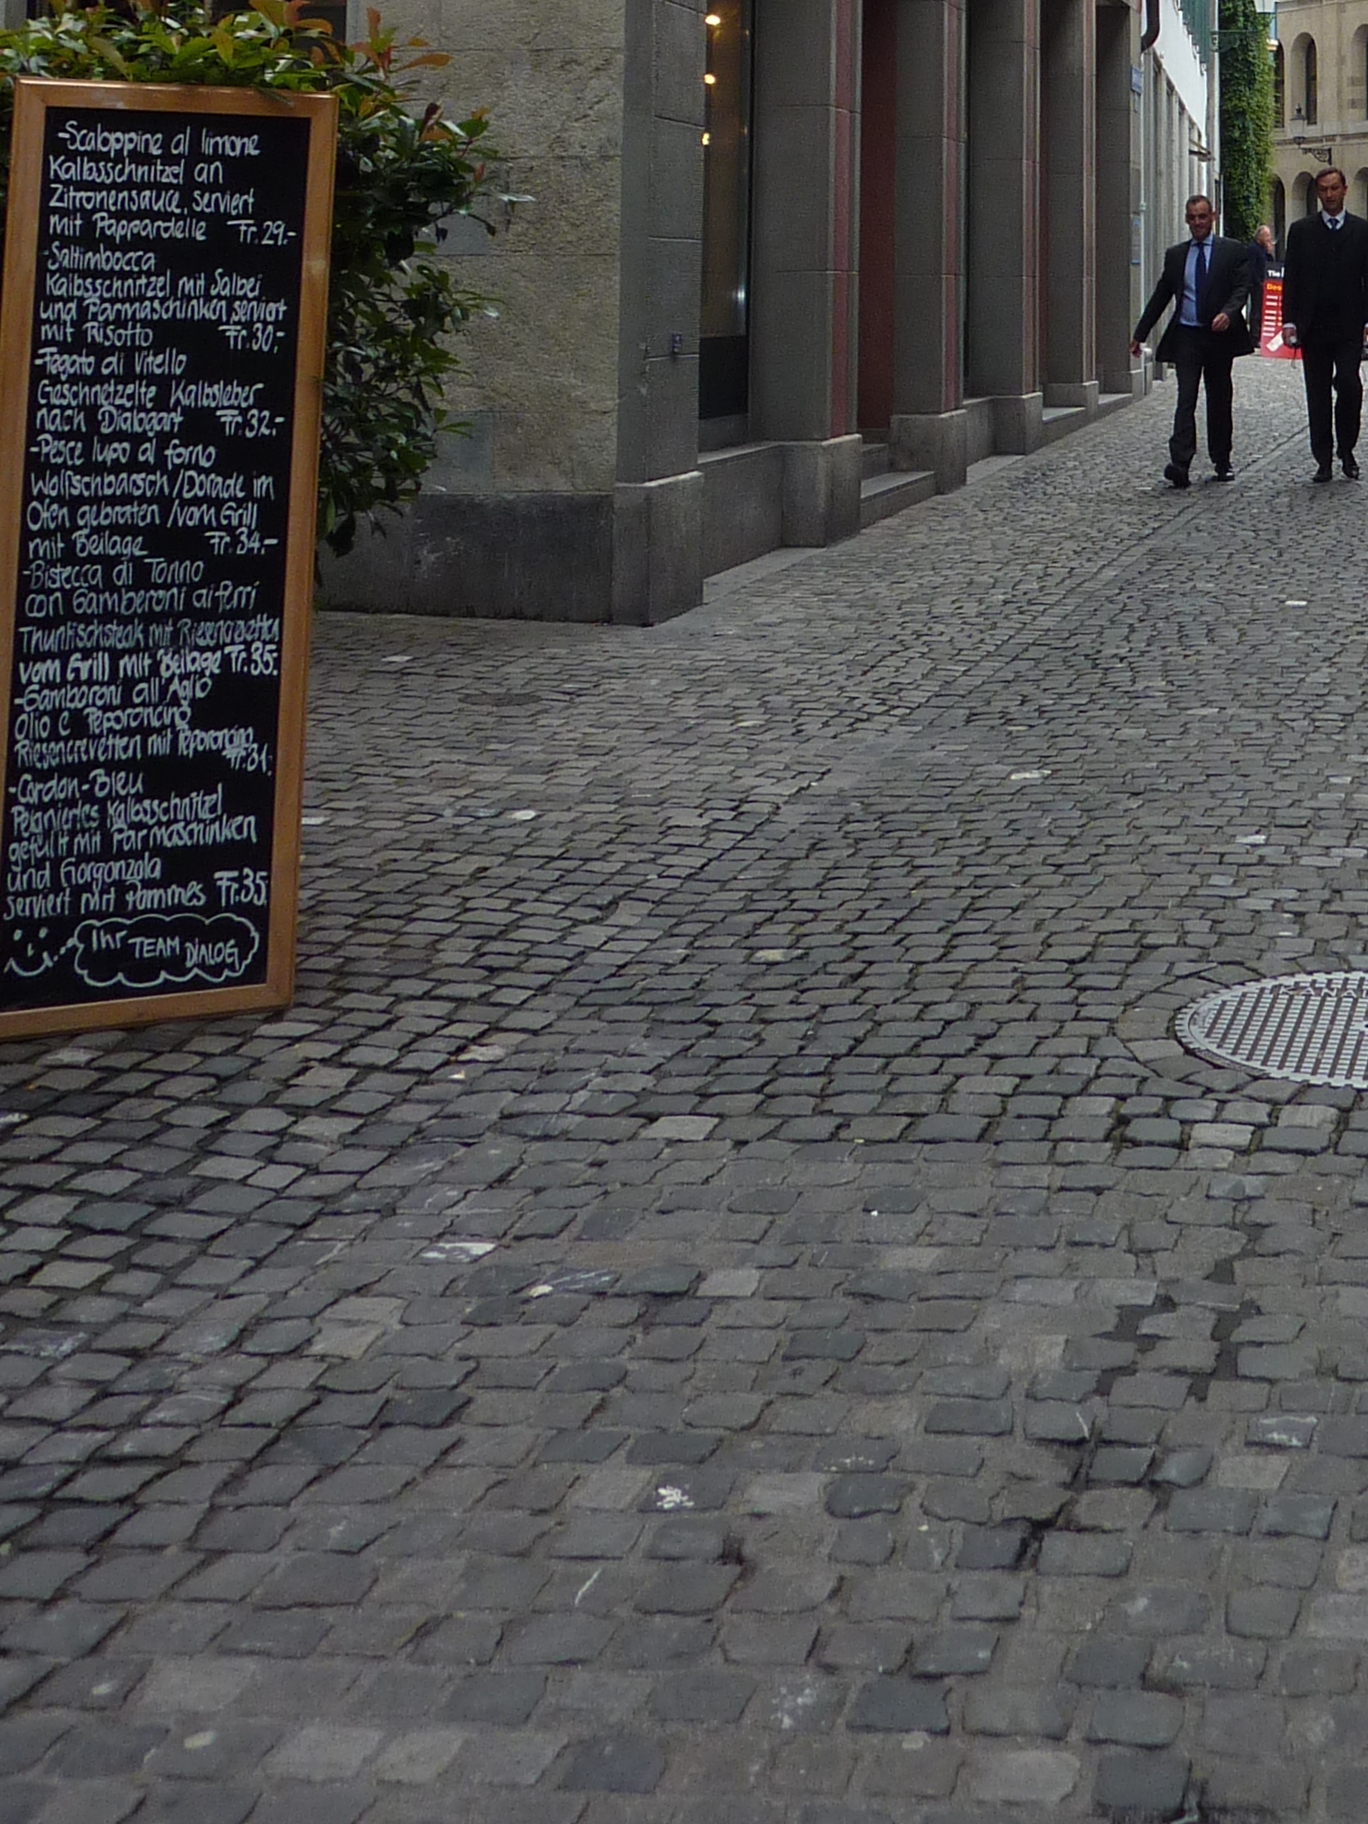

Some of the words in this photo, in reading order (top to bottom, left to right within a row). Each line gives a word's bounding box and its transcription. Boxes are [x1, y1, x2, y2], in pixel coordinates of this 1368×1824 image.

[170, 125, 191, 157] al
[201, 127, 261, 158] limone
[49, 154, 185, 185] Kalbsschnitzel
[194, 160, 224, 185] an
[192, 187, 255, 216] serviert
[92, 211, 207, 245] Pappardelle
[46, 269, 171, 299] Kalbsschnitzel
[178, 272, 205, 298] mit
[210, 267, 263, 298] Salbei
[40, 298, 78, 321] und
[41, 322, 76, 343] mit
[82, 321, 153, 347] Risotto
[101, 350, 125, 376] di
[135, 347, 188, 376] Vitello
[38, 378, 157, 409] Geschnetzelte
[169, 379, 265, 409] Kalbsleber
[36, 407, 87, 432] nach
[91, 435, 131, 467] lupo
[137, 438, 157, 466] al
[164, 438, 217, 471] forno
[26, 499, 70, 532] Ofen
[76, 500, 161, 534] gebraten
[220, 501, 258, 529] Grill
[28, 532, 66, 560] mit
[71, 530, 149, 560] Beilage
[112, 557, 133, 586] di
[143, 558, 204, 584] Tonno
[25, 590, 65, 618] con
[19, 659, 62, 685] vom
[66, 651, 110, 682] Grill
[119, 652, 153, 680] mit
[157, 647, 222, 678] Beilage
[14, 710, 52, 741] Olio
[148, 727, 173, 756] mit
[73, 830, 101, 857] mit
[60, 851, 162, 894] Gorgonzola
[3, 887, 72, 921] serviert
[80, 887, 116, 915] mit
[91, 928, 128, 952] Ihr
[127, 935, 180, 960] TEAM
